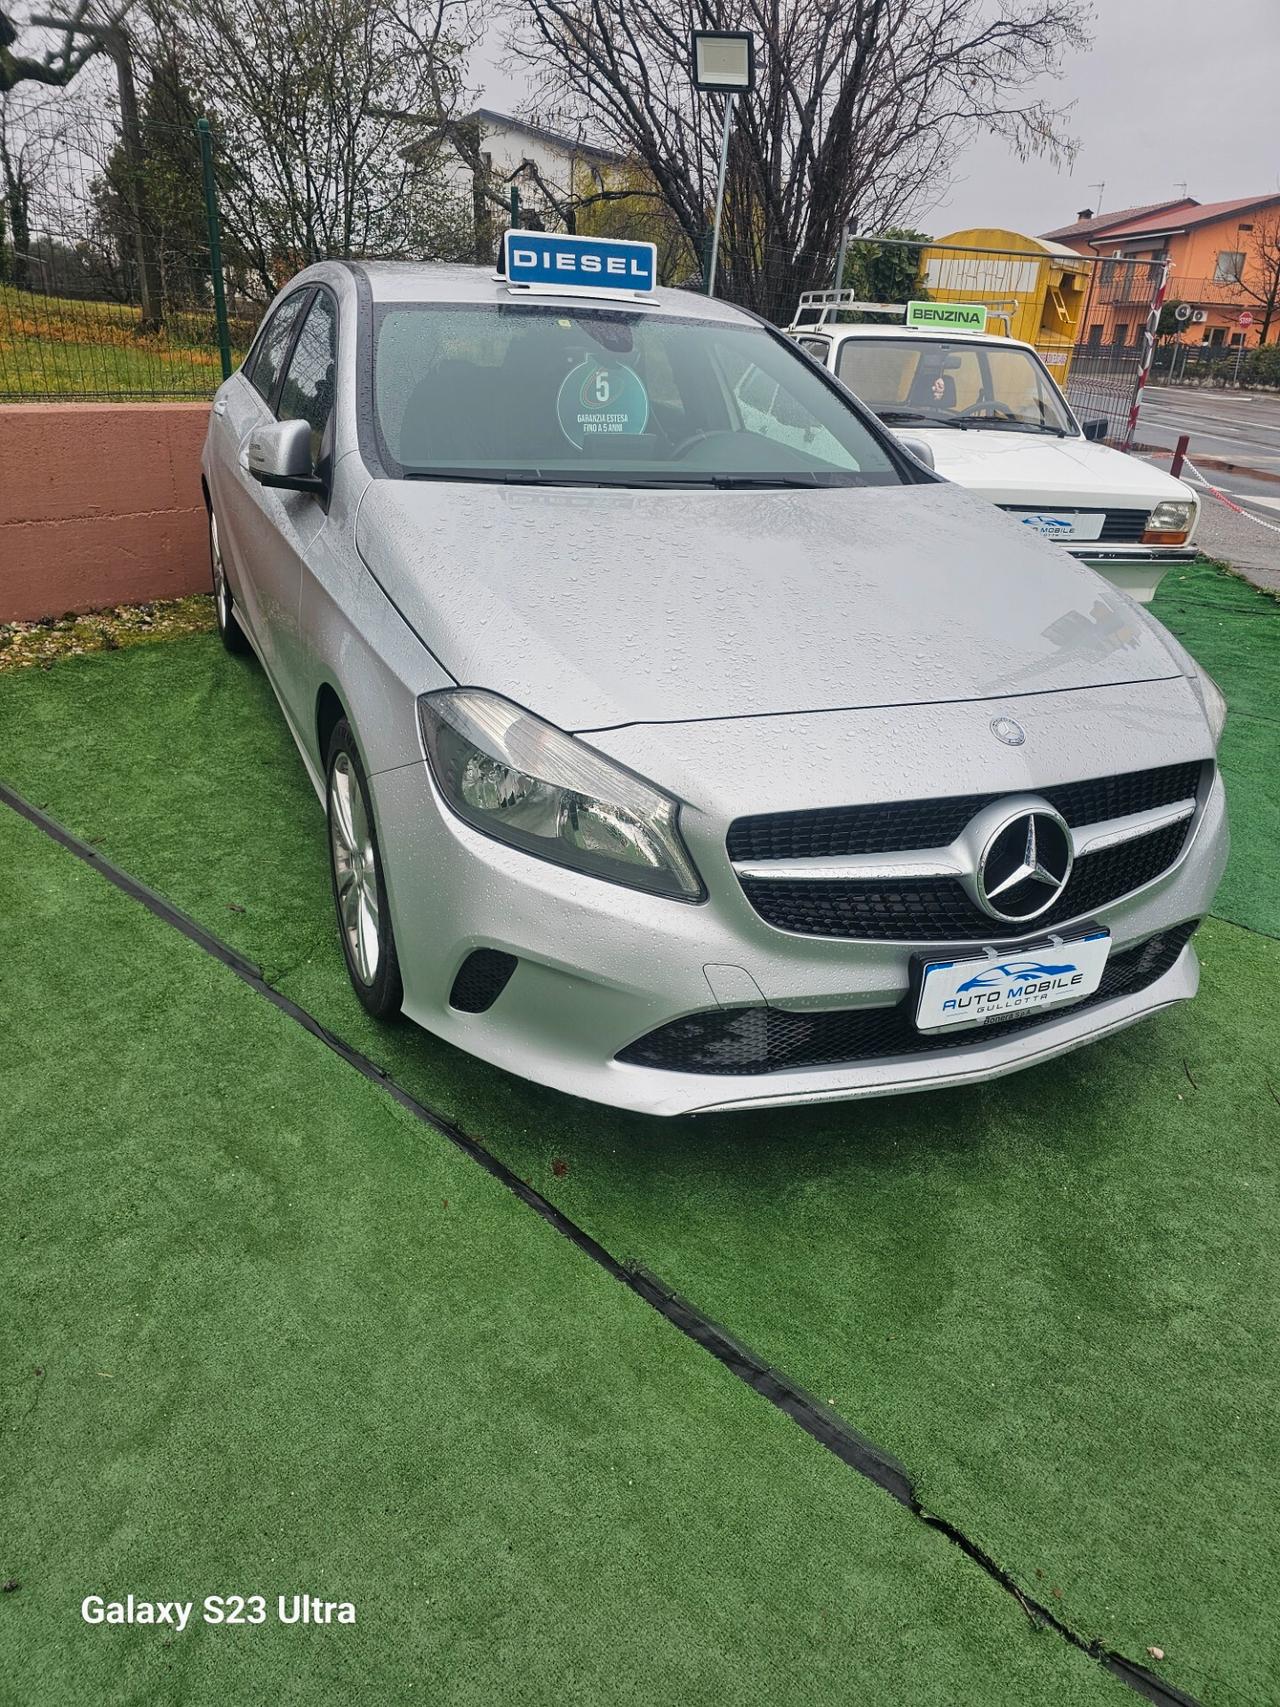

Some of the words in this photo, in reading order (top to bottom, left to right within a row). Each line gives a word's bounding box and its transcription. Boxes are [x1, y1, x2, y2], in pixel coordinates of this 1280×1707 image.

[513, 250, 648, 276] DIESEL
[913, 308, 980, 324] BENZINA
[596, 371, 610, 401] 5
[577, 414, 605, 423] GARANZIA
[606, 414, 628, 423] ESTESA
[583, 423, 597, 432] FINO
[597, 423, 602, 432] A
[602, 423, 608, 432] 5
[608, 423, 623, 432] ANNI
[942, 991, 1000, 1011] AUTO
[1007, 973, 1084, 998] MOBILE
[976, 993, 1048, 1013] GULLOTTA
